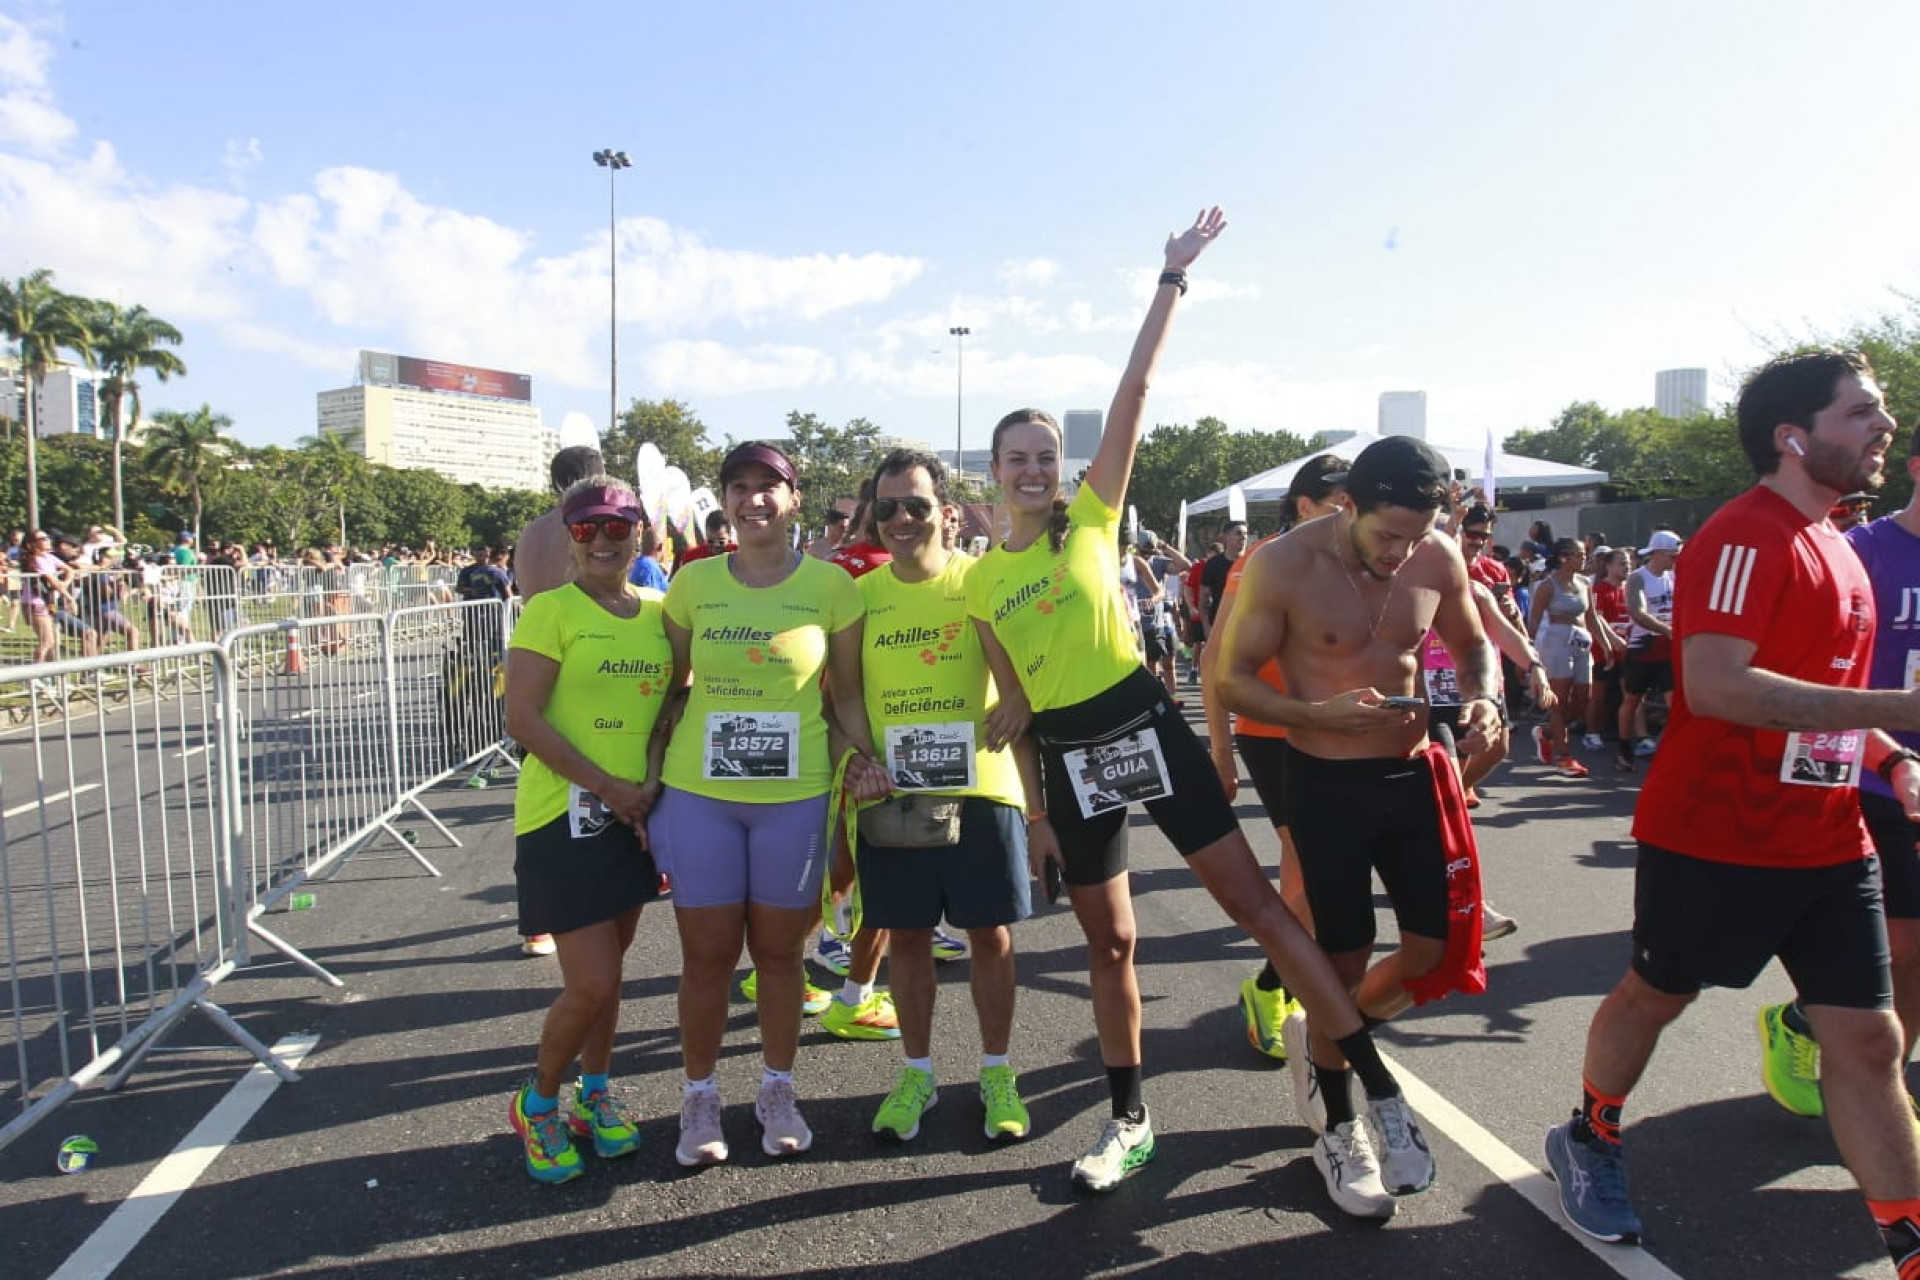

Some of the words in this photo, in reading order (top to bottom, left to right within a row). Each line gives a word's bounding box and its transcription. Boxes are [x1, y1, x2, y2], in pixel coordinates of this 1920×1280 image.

[994, 577, 1050, 627] Achilles
[701, 627, 774, 641] Achilles
[874, 627, 940, 649] Achilles
[597, 659, 661, 674] Achilles
[884, 696, 965, 714] Deficiência
[594, 717, 623, 729] Guia
[727, 736, 784, 751] 13572
[910, 747, 962, 763] 13612
[1103, 757, 1149, 780] GUIA
